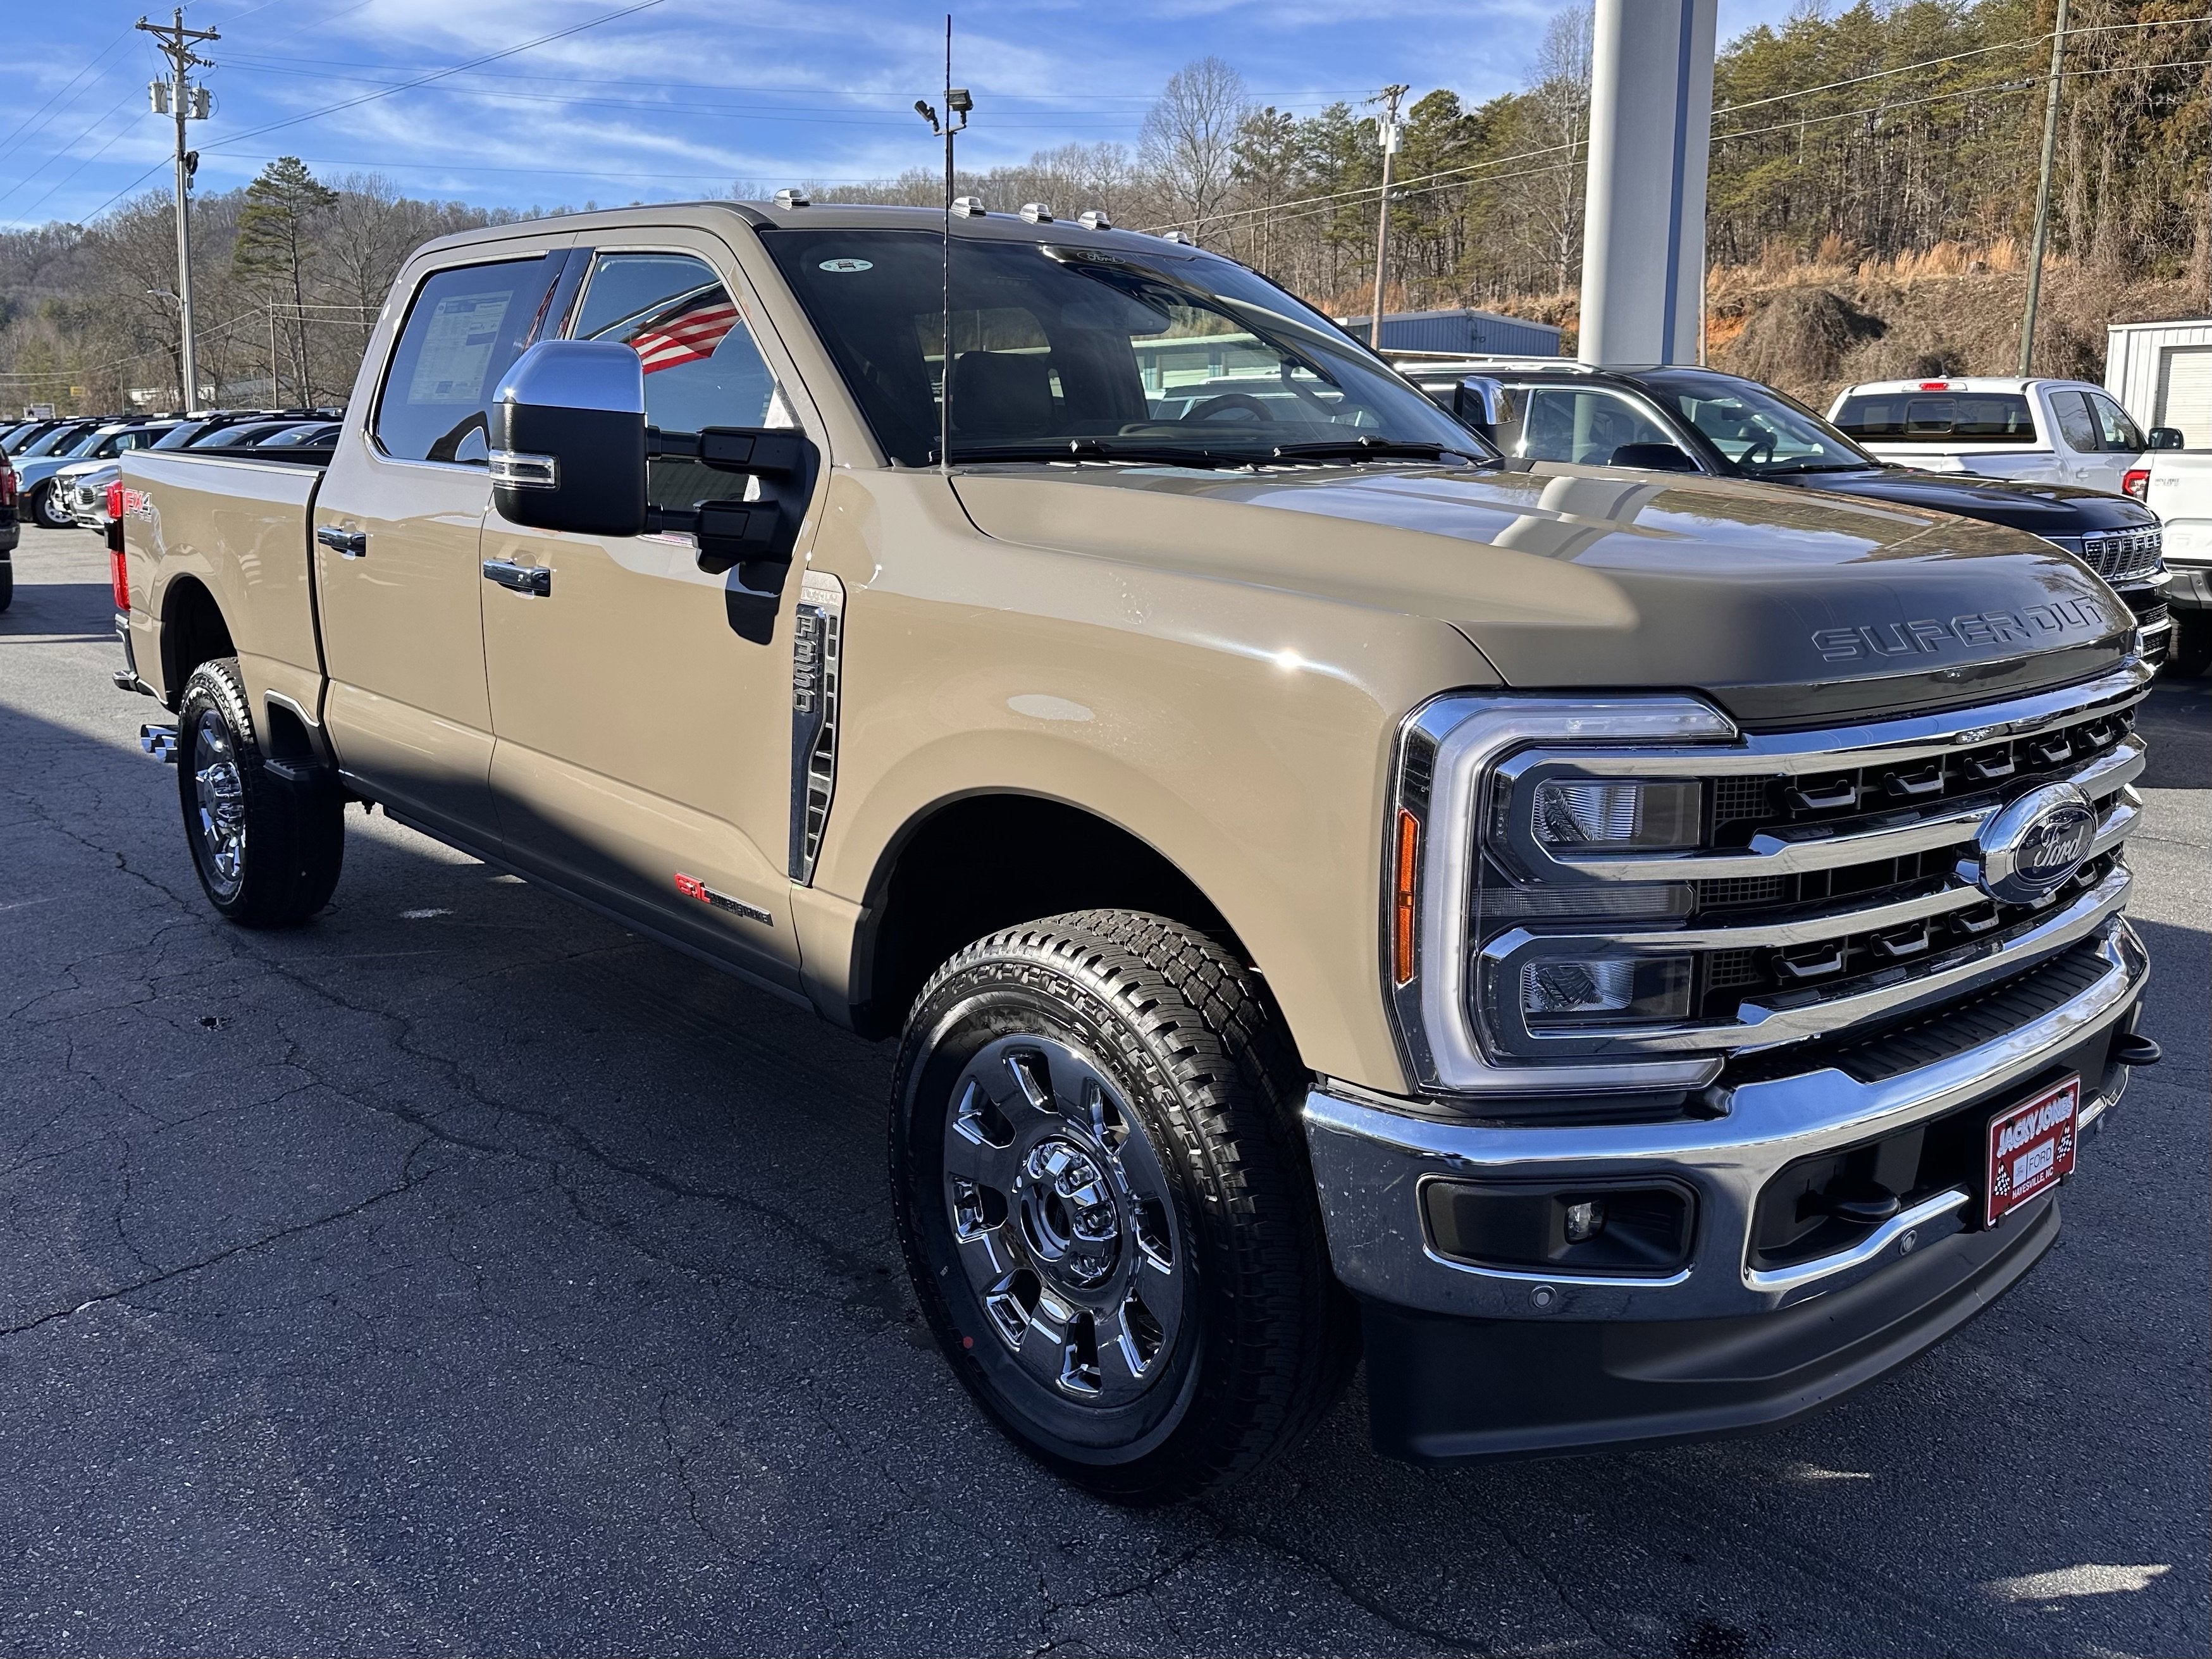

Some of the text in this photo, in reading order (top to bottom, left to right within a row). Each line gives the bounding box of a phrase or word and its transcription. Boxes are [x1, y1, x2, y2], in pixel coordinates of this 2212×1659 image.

[1087, 252, 1118, 263] Ford
[125, 488, 152, 517] FX4
[1810, 610, 2030, 662] SUPER
[2032, 818, 2084, 868] Ford
[1996, 1090, 2075, 1159] JACKY JONES
[2029, 1147, 2052, 1172] FORD
[2012, 1175, 2045, 1200] HAYESVILLE,
[2045, 1166, 2054, 1181] NC
